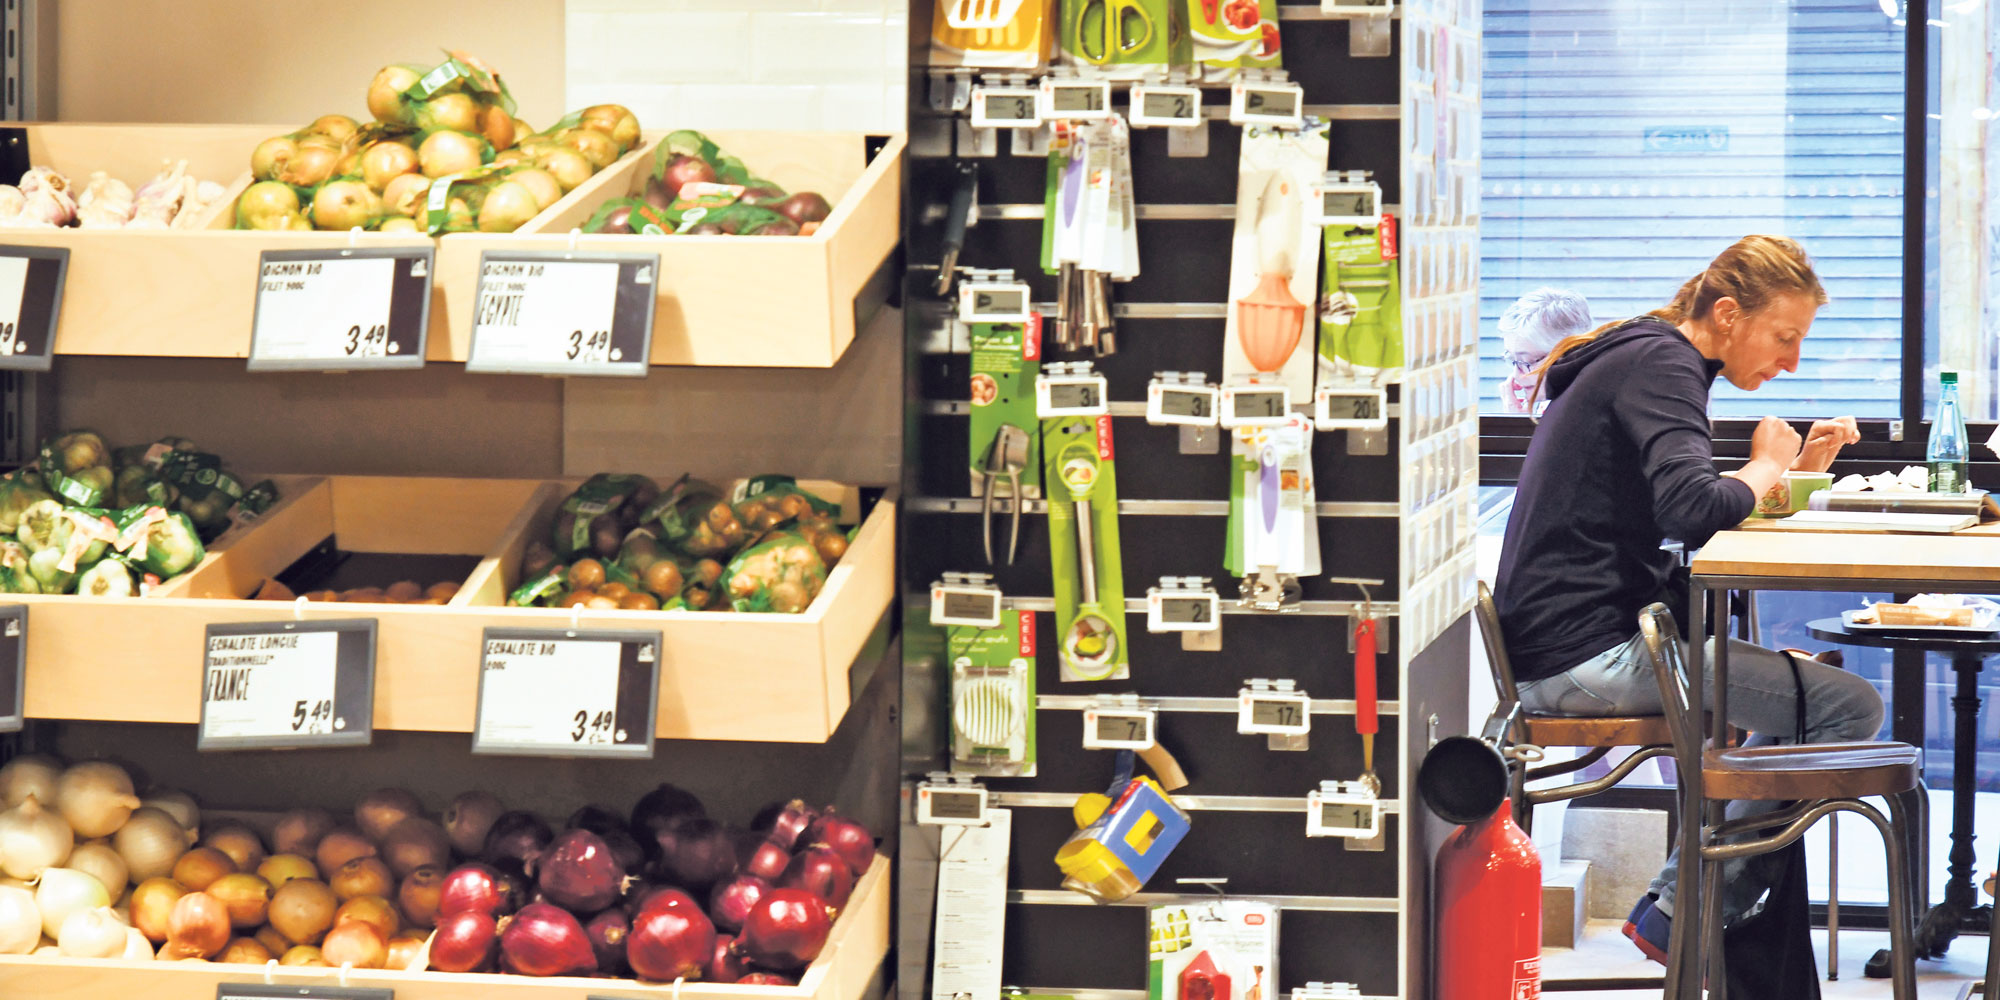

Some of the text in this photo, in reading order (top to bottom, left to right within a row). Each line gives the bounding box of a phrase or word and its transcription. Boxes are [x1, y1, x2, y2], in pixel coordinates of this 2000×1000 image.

[1173, 98, 1186, 118] 2
[1354, 196, 1364, 216] 4
[263, 263, 323, 277] OIGNON BIO
[483, 264, 545, 277] OIGNON BIO
[261, 281, 284, 292] FILET
[477, 294, 524, 326] EGYPTE
[344, 325, 361, 355] 3
[364, 324, 385, 344] 49
[566, 330, 583, 360] 3
[586, 330, 608, 350] 49
[1353, 400, 1371, 419] 20
[1192, 603, 1202, 622] 2
[209, 635, 299, 652] ECHALOTE LONGUE
[486, 642, 556, 656] ECHALOTE BIO
[206, 668, 252, 702] FRANCE
[291, 700, 308, 731] 5
[310, 699, 332, 721] 49
[1277, 706, 1294, 725] 17
[571, 710, 588, 743] 3
[591, 710, 613, 732] 49
[1126, 721, 1138, 741] 7
